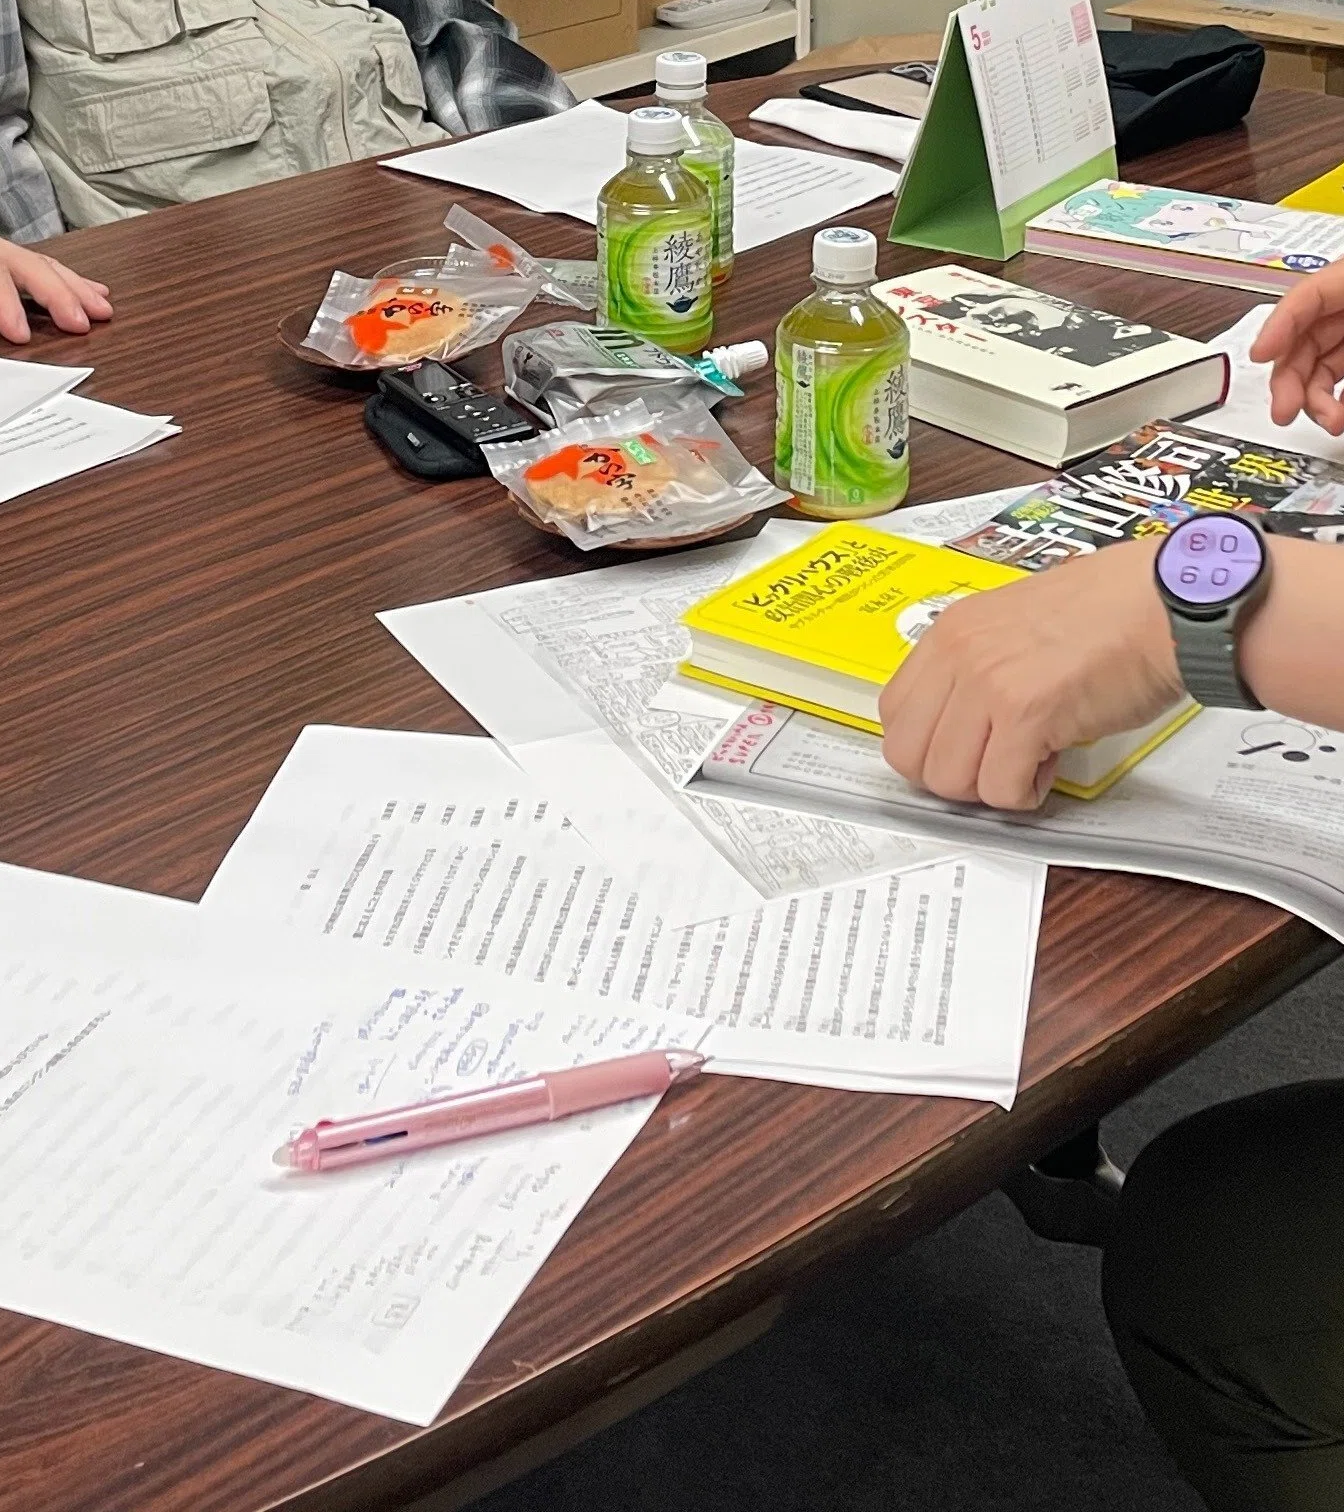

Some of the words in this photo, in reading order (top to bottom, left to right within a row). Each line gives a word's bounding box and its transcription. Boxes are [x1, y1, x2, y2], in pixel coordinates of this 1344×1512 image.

[970, 24, 982, 51] 5
[663, 230, 695, 296] 綾鷹
[884, 364, 907, 441] 綾鷹
[995, 430, 1240, 558] 寺山修司
